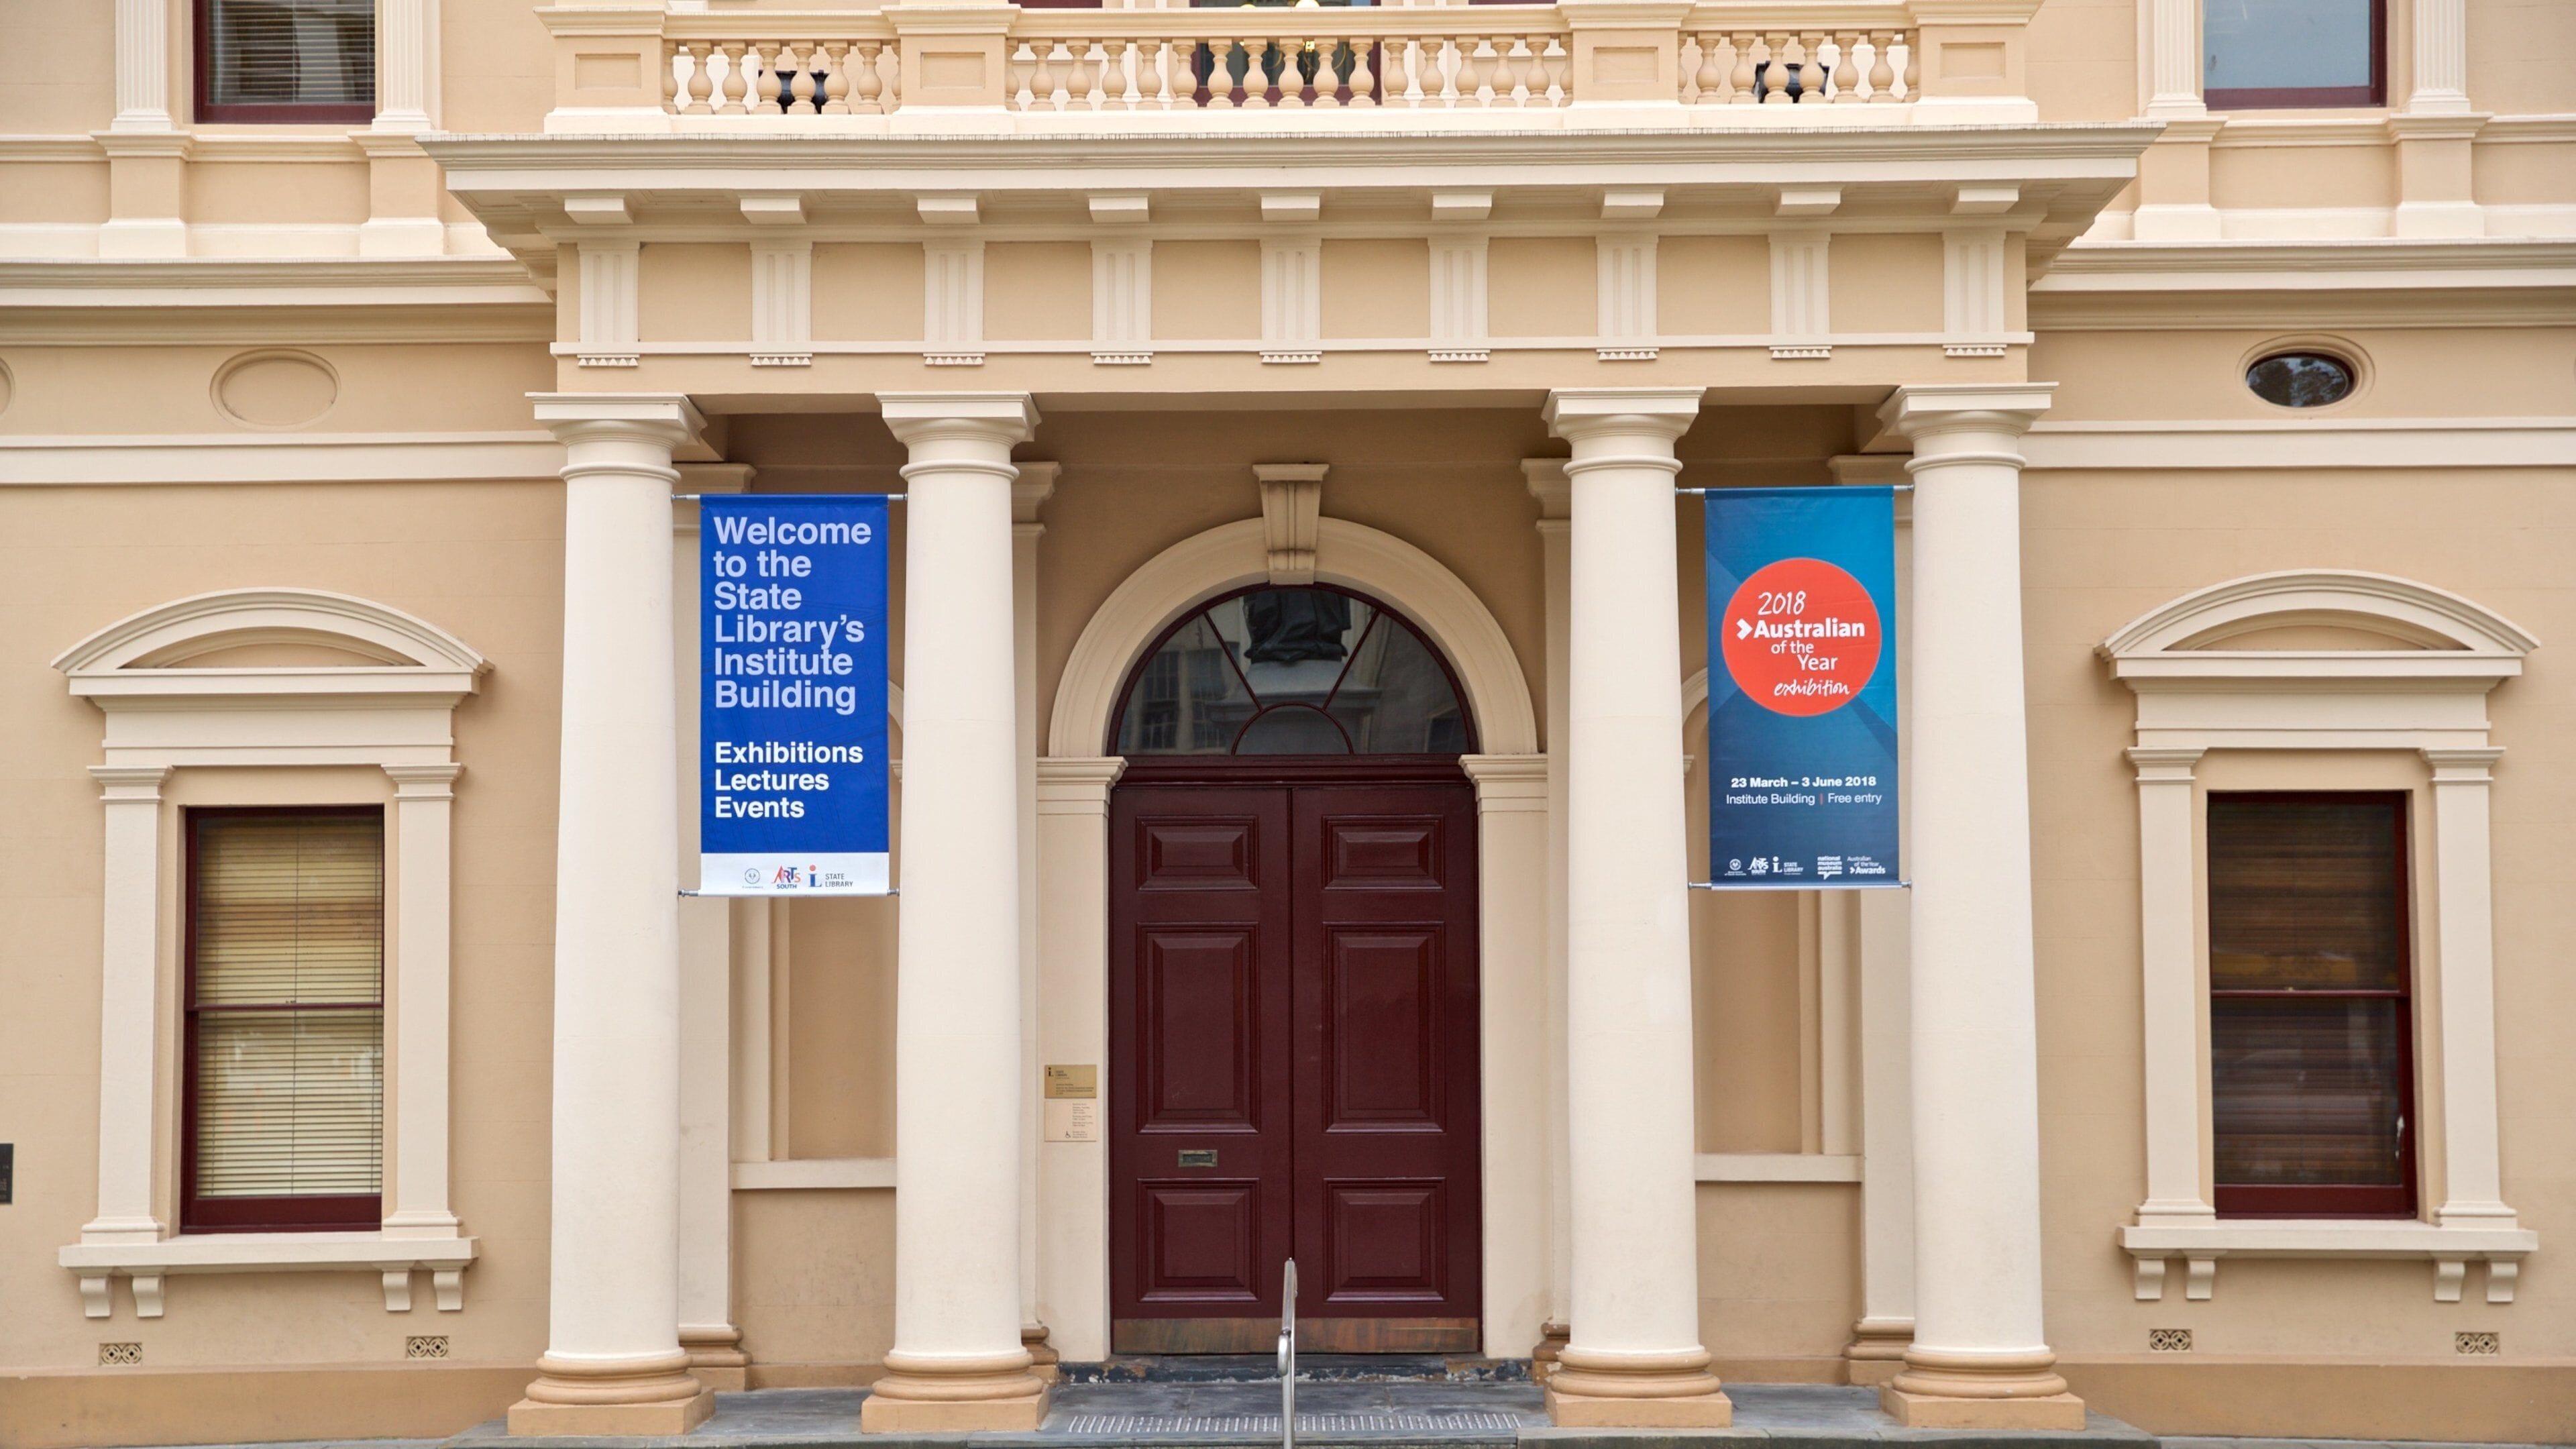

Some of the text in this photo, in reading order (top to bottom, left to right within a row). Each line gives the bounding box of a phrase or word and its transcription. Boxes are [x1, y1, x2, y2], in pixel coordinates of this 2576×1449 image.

[714, 517, 871, 545] Welcome
[714, 549, 811, 577] to the
[714, 582, 802, 610] State
[1758, 590, 1806, 615] 2018
[714, 614, 864, 650] Library’s
[1754, 618, 1864, 638] Australian
[1771, 640, 1814, 653] of the
[714, 648, 853, 675] Institute
[1797, 654, 1837, 670] Year
[716, 680, 855, 715] Building
[1774, 678, 1849, 696] exhibition
[716, 741, 863, 763] Exhibitions
[716, 769, 829, 790] Lectures
[1731, 777, 1747, 788] 23
[1750, 777, 1788, 787] March
[1802, 777, 1810, 787] 3
[1813, 777, 1842, 787] June
[1845, 776, 1876, 786] 2018
[716, 796, 804, 818] Events
[1727, 793, 1882, 806] Institute Building Free entry
[772, 865, 801, 883] ARTS
